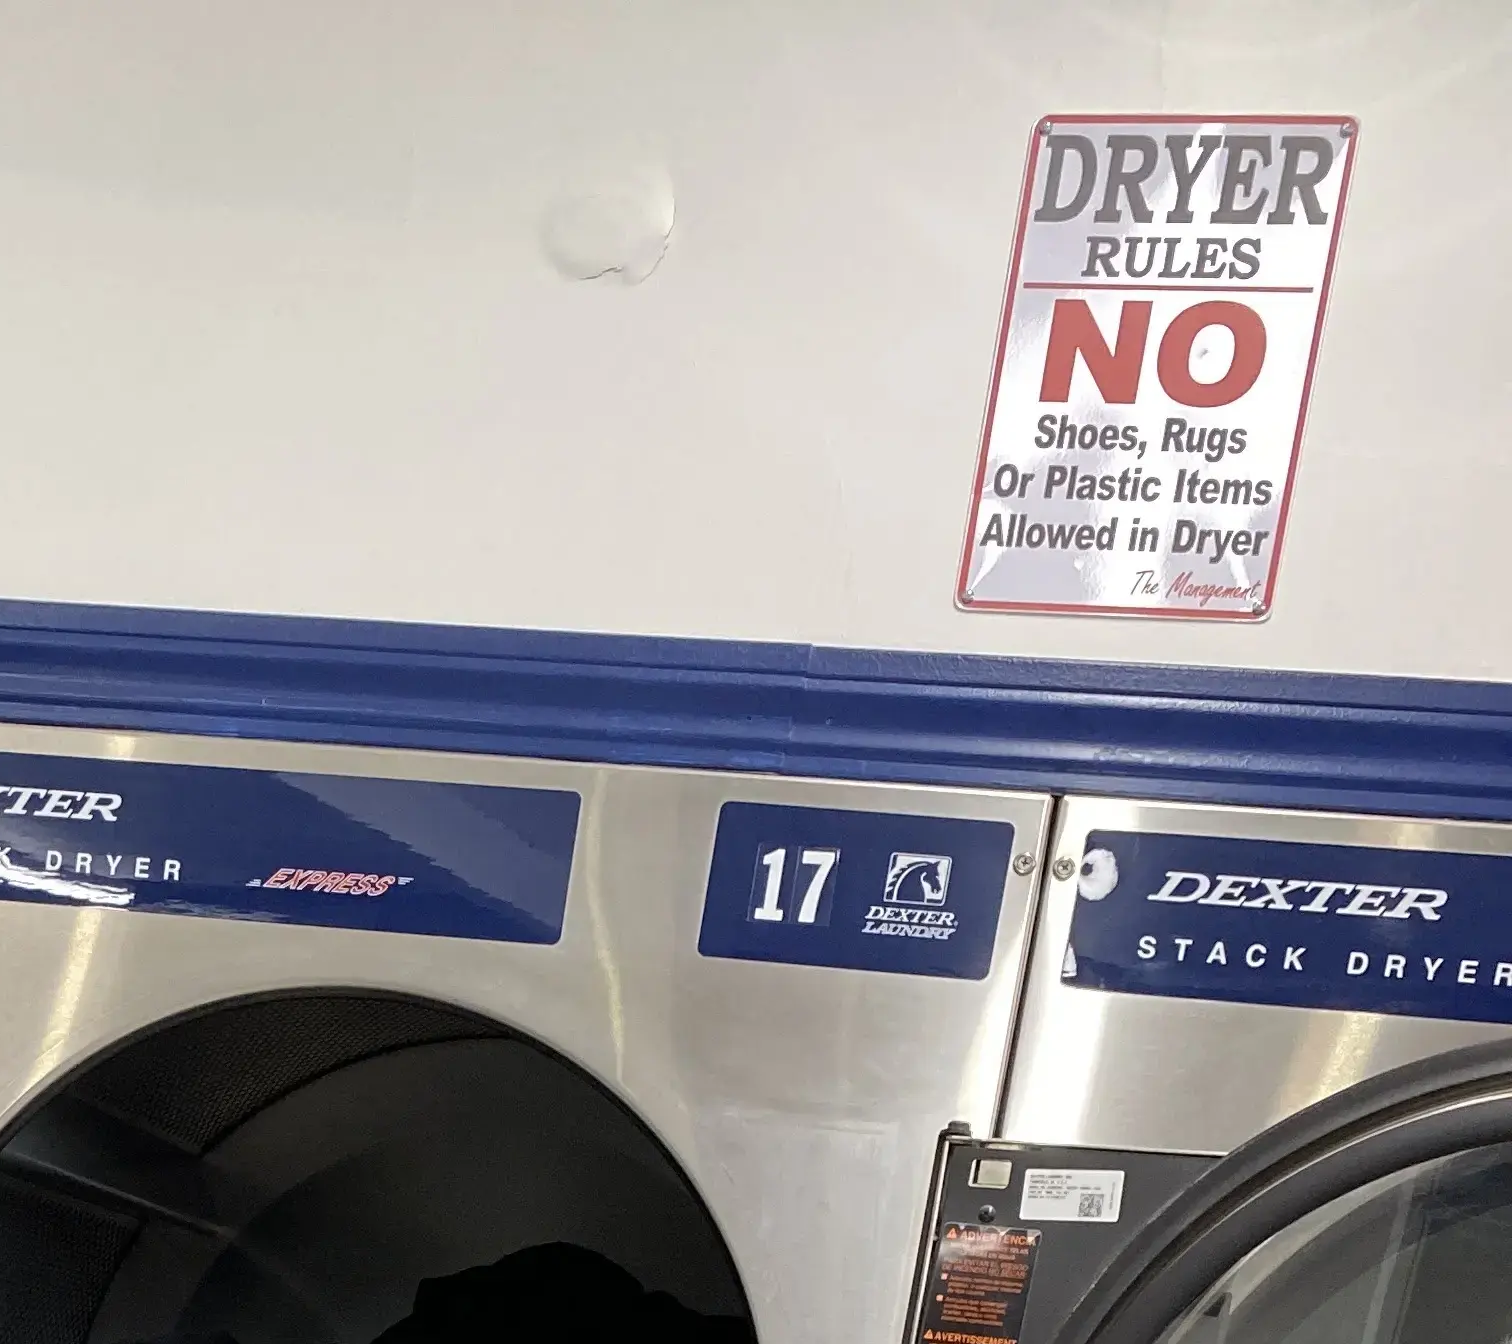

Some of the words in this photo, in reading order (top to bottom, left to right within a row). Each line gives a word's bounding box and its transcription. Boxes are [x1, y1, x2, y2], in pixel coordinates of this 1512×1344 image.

[1034, 134, 1333, 225] DRYER
[1082, 236, 1262, 279] RULES
[1038, 299, 1267, 408] NO
[1035, 414, 1146, 458] Shoes,
[1162, 419, 1247, 462] Rugs
[993, 463, 1034, 499] Or
[1044, 465, 1161, 503] Plastic
[1173, 471, 1272, 507] Items
[981, 514, 1117, 552] Allowed
[1129, 517, 1158, 553] in
[1172, 520, 1268, 564] Dryer
[1130, 571, 1159, 595] The
[1166, 572, 1260, 607] Management
[45, 851, 183, 882] DRYER
[265, 869, 395, 897] EXPRESS
[753, 848, 836, 923] 17
[865, 905, 958, 927] DEXTER
[1147, 870, 1449, 921] DEXTER
[862, 921, 956, 941] LAUNDRY
[1136, 935, 1307, 972] STACK
[1347, 950, 1512, 989] DRYER
